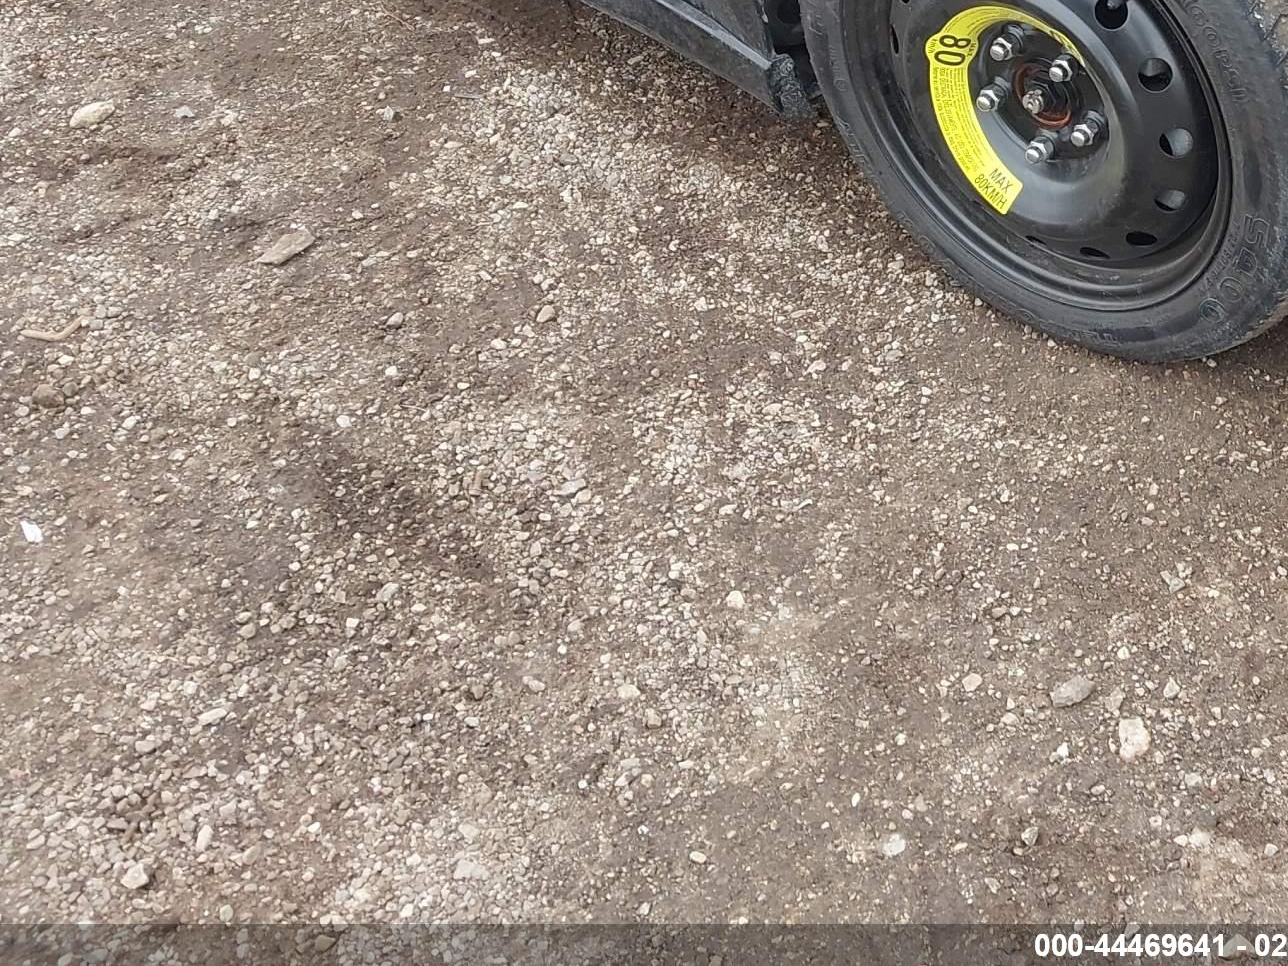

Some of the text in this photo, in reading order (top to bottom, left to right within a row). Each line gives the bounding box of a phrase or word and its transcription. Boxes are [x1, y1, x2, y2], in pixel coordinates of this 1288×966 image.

[934, 35, 972, 67] 80
[974, 174, 1009, 210] 80KM/H
[988, 168, 1014, 195] MAX
